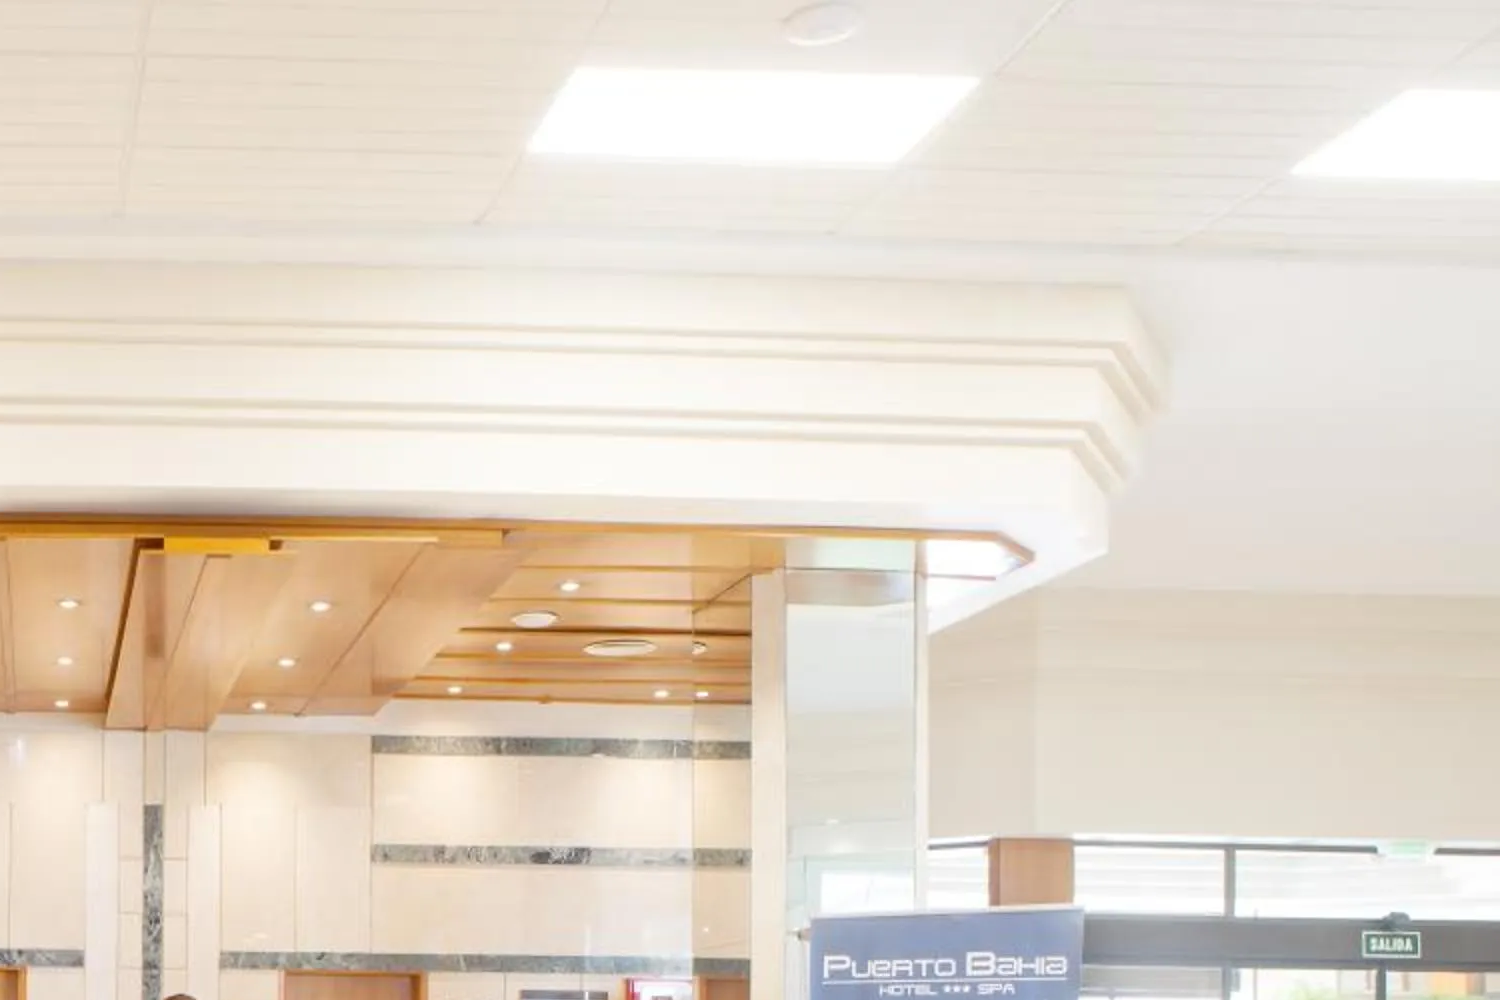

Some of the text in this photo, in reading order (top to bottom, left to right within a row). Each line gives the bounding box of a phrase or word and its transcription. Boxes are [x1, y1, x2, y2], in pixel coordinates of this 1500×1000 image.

[1370, 936, 1413, 952] SALIDA
[879, 983, 1016, 996] HOTEL SPA
